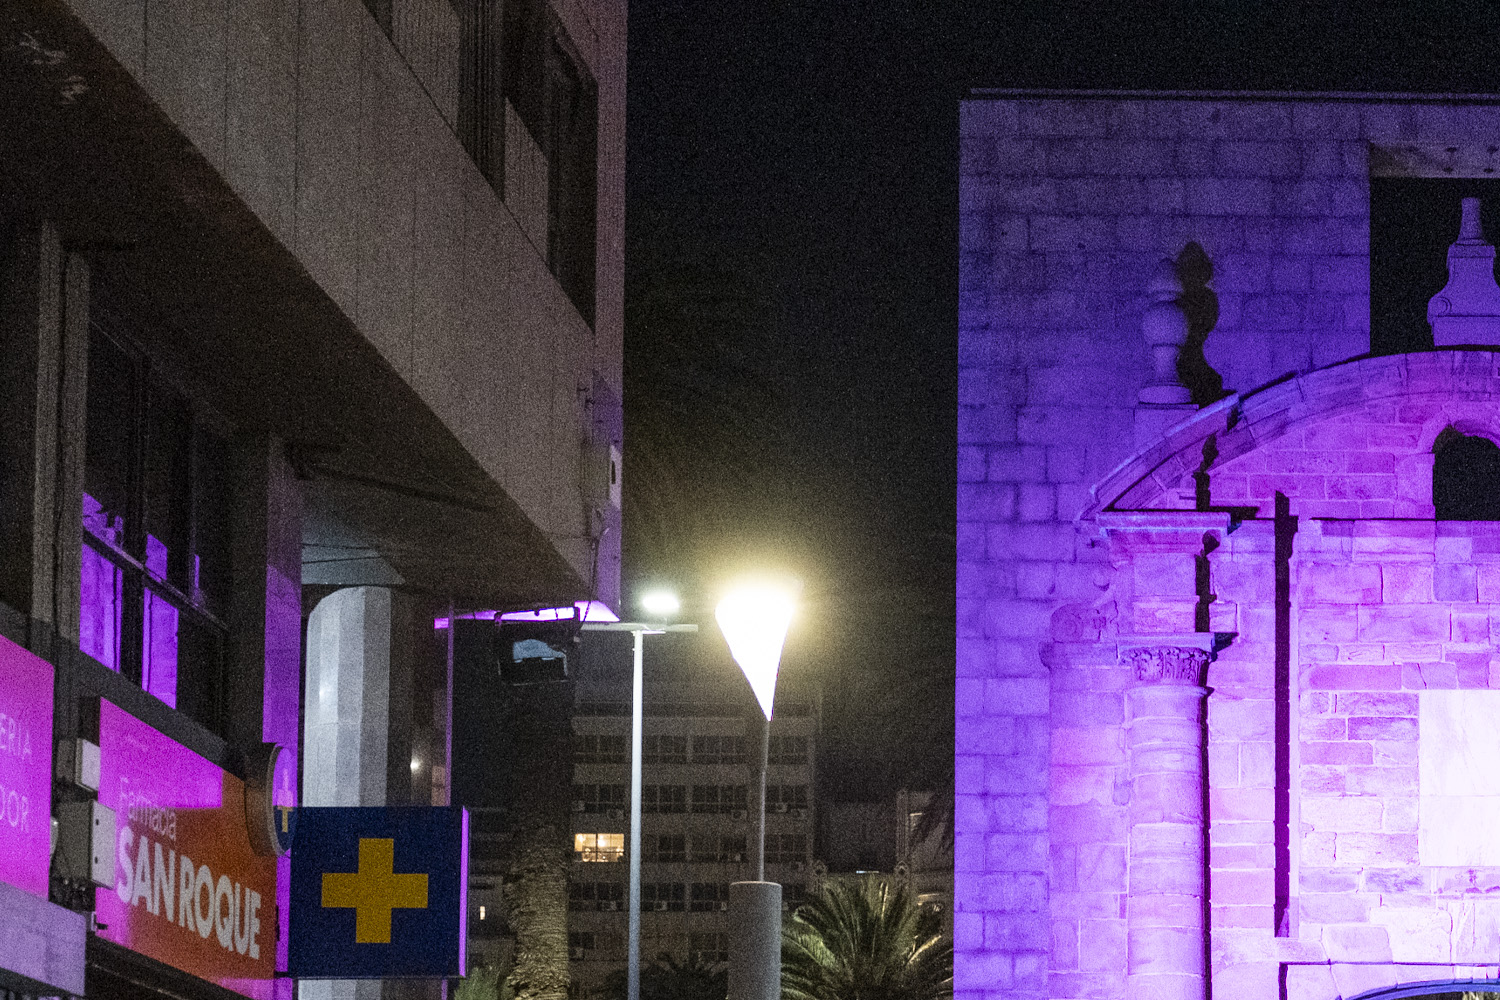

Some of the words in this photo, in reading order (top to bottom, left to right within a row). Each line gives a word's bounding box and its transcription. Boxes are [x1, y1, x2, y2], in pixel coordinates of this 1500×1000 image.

[118, 776, 177, 842] Farmacia
[117, 826, 175, 923] SAN
[179, 854, 261, 960] ROQUE
